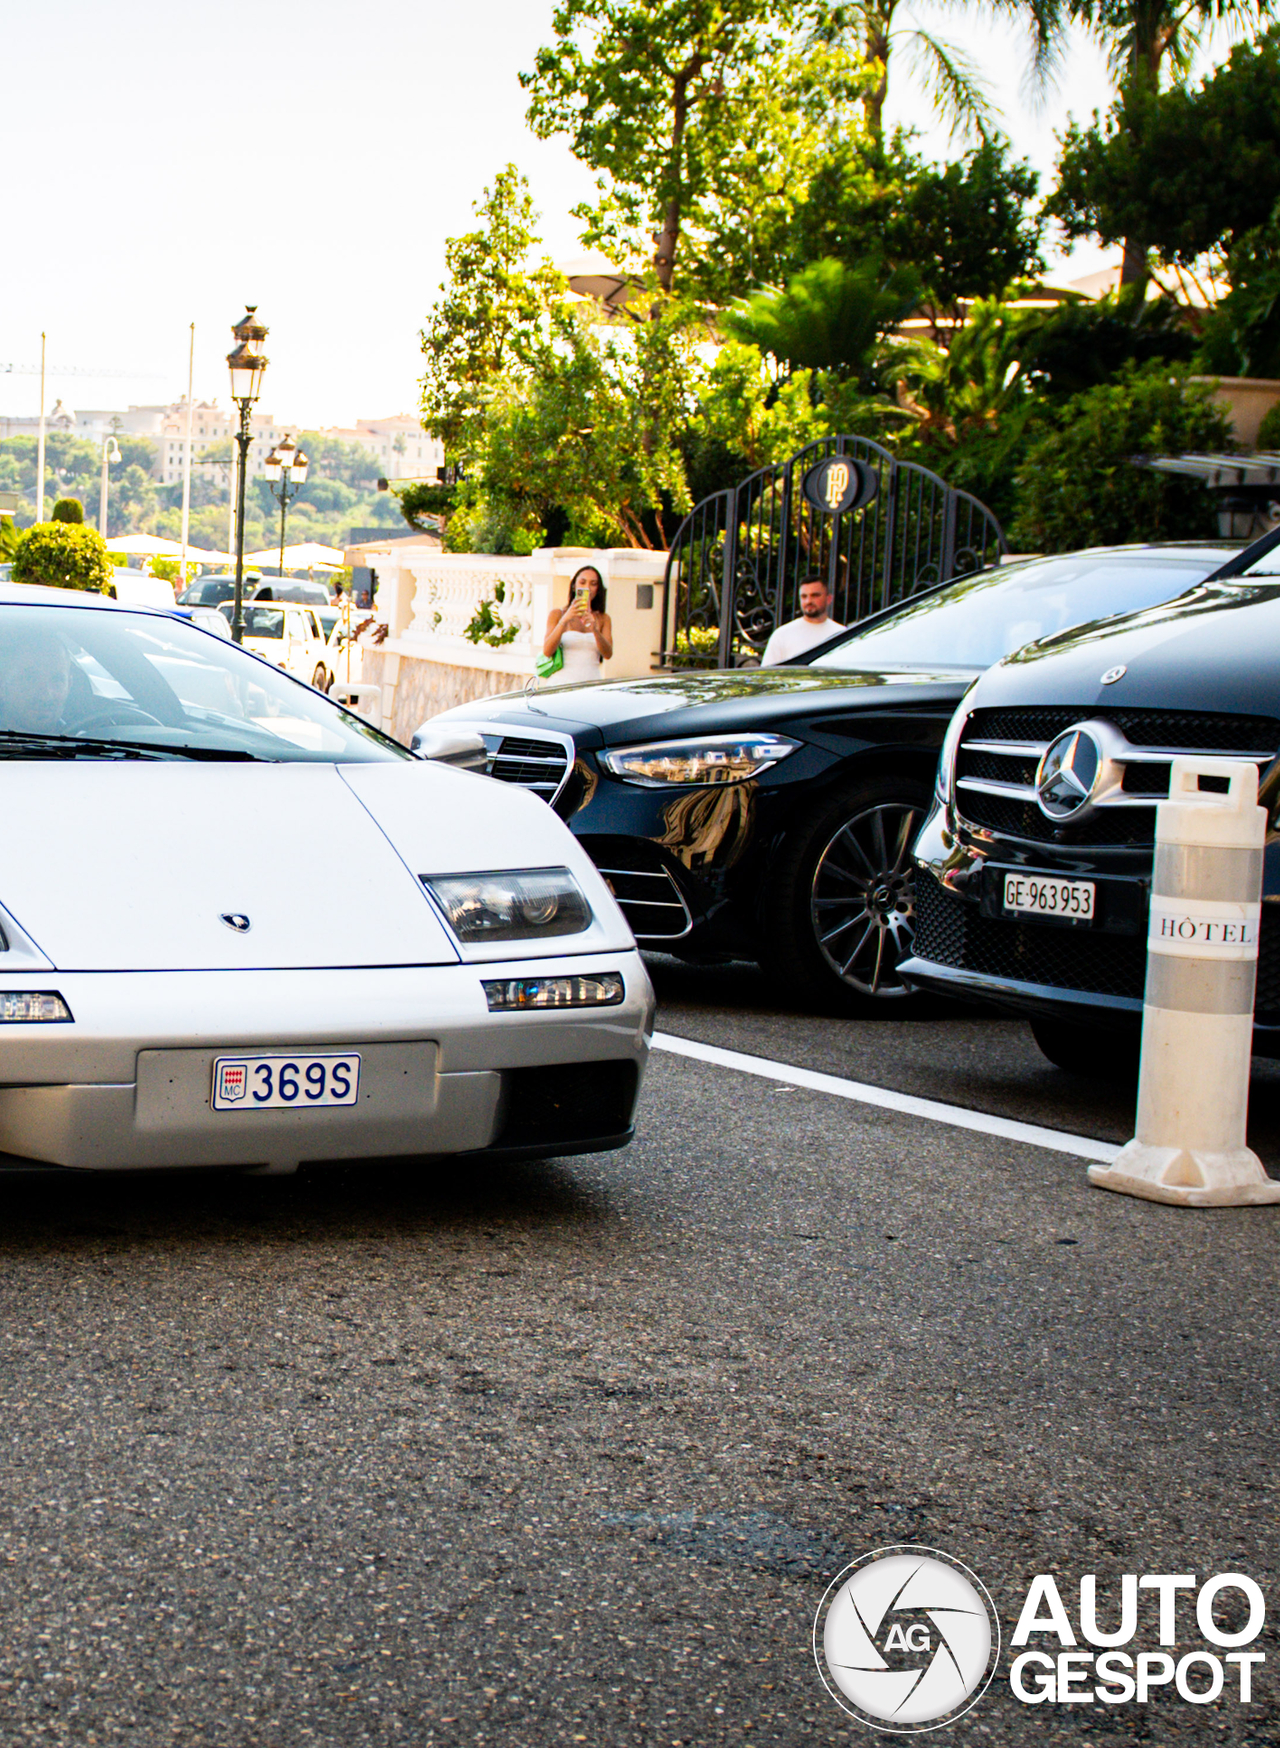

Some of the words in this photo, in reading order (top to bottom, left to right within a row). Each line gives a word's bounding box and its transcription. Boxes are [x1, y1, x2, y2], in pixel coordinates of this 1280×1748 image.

[1161, 916, 1252, 943] HÔTEL
[224, 1085, 241, 1096] MC
[252, 1062, 351, 1102] 369S
